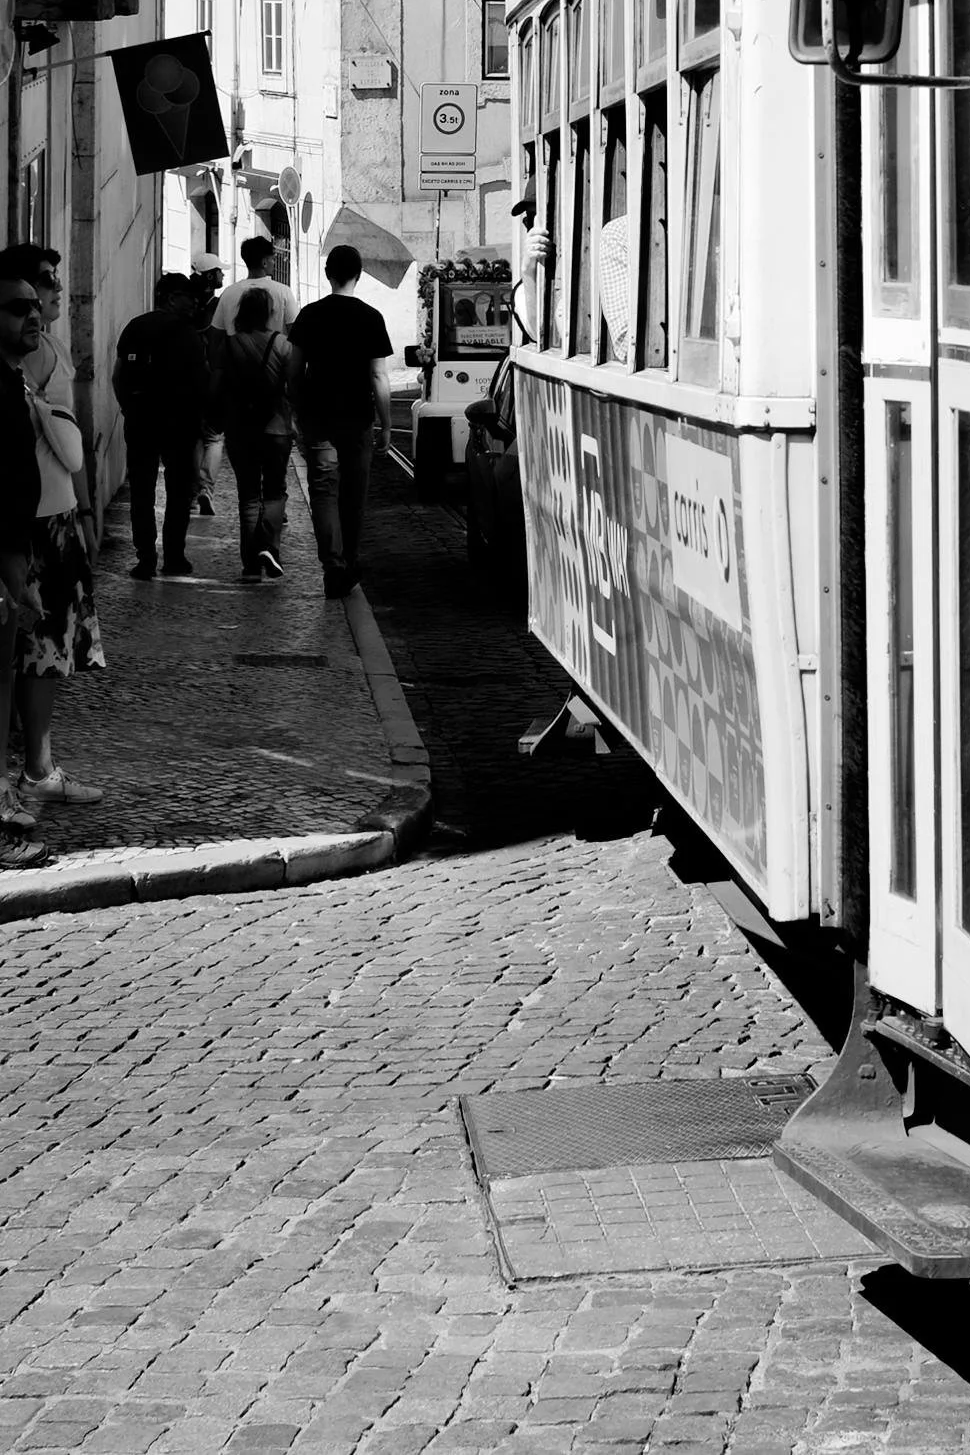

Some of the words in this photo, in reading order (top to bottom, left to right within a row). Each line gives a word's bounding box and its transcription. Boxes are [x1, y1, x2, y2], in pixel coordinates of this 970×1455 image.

[583, 486, 611, 600] MB
[606, 515, 630, 599] WAY
[674, 478, 709, 559] carris
